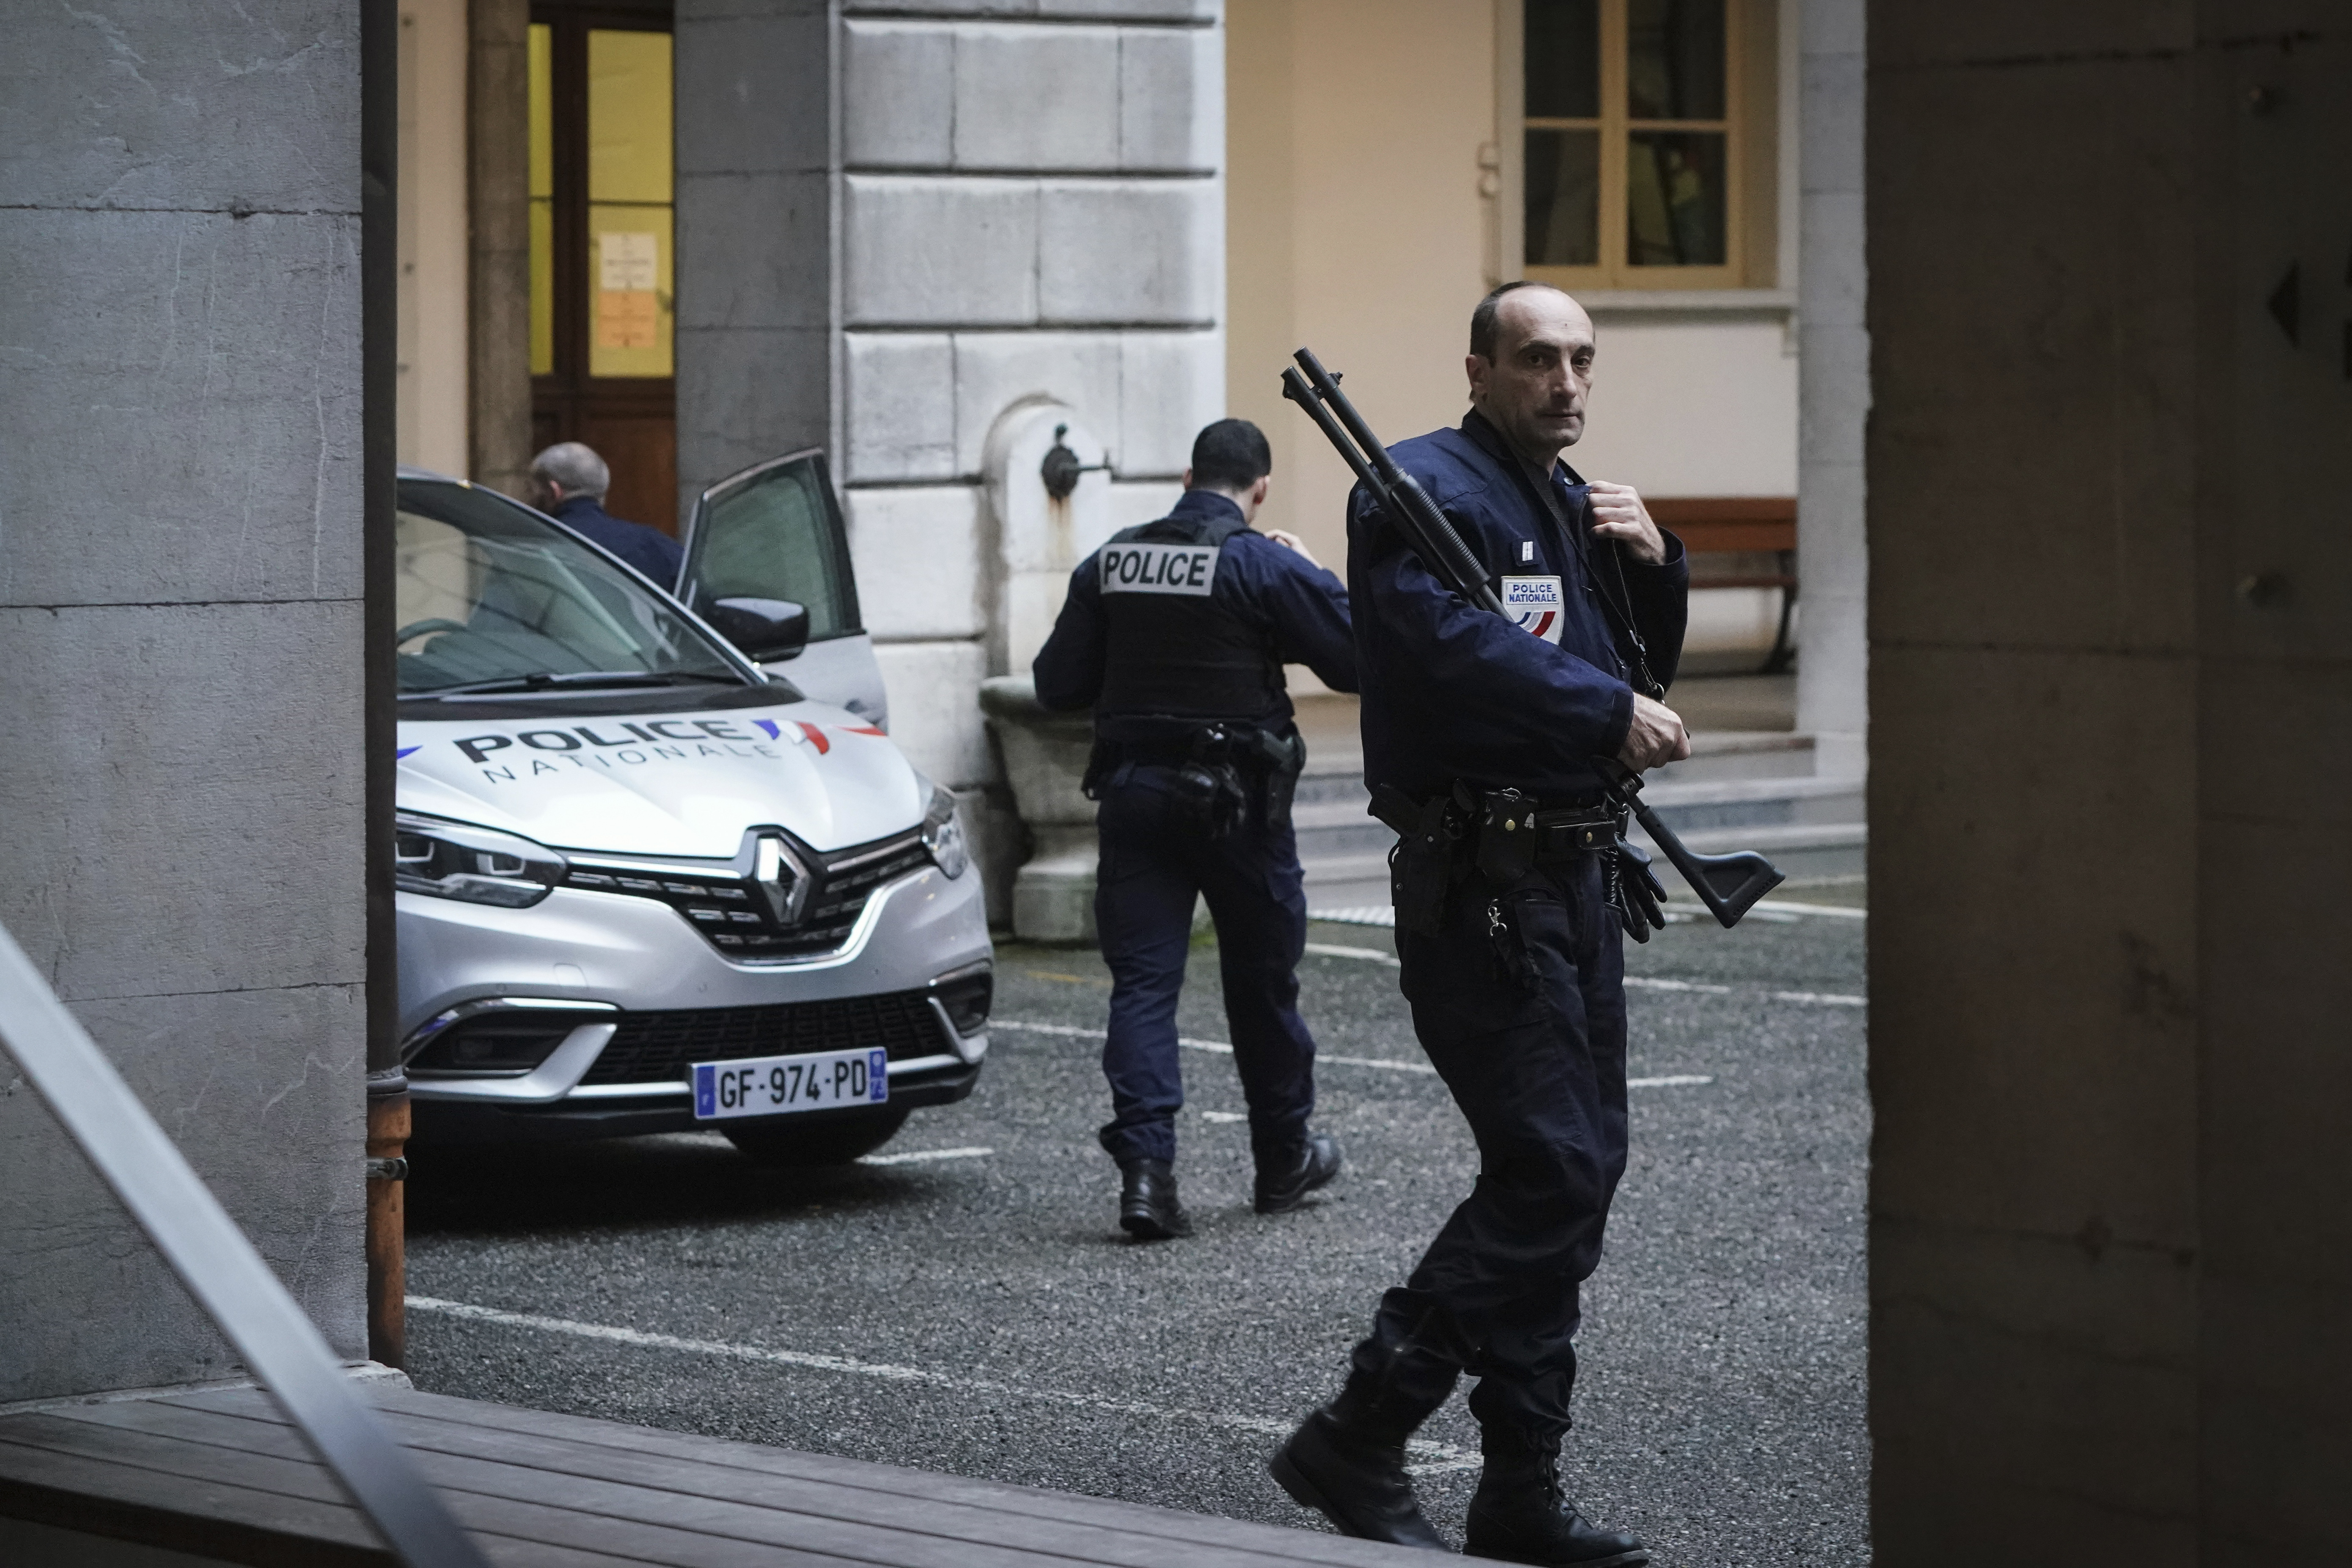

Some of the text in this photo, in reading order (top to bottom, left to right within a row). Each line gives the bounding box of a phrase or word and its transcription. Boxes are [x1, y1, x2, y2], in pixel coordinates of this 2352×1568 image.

[1104, 550, 1209, 586] POLICE
[1509, 594, 1557, 602] NATIONALE
[1513, 584, 1553, 593] POLICE
[453, 721, 754, 763] POLICE
[483, 744, 782, 784] NATIONALE
[720, 1059, 867, 1109] GF-974-PD
